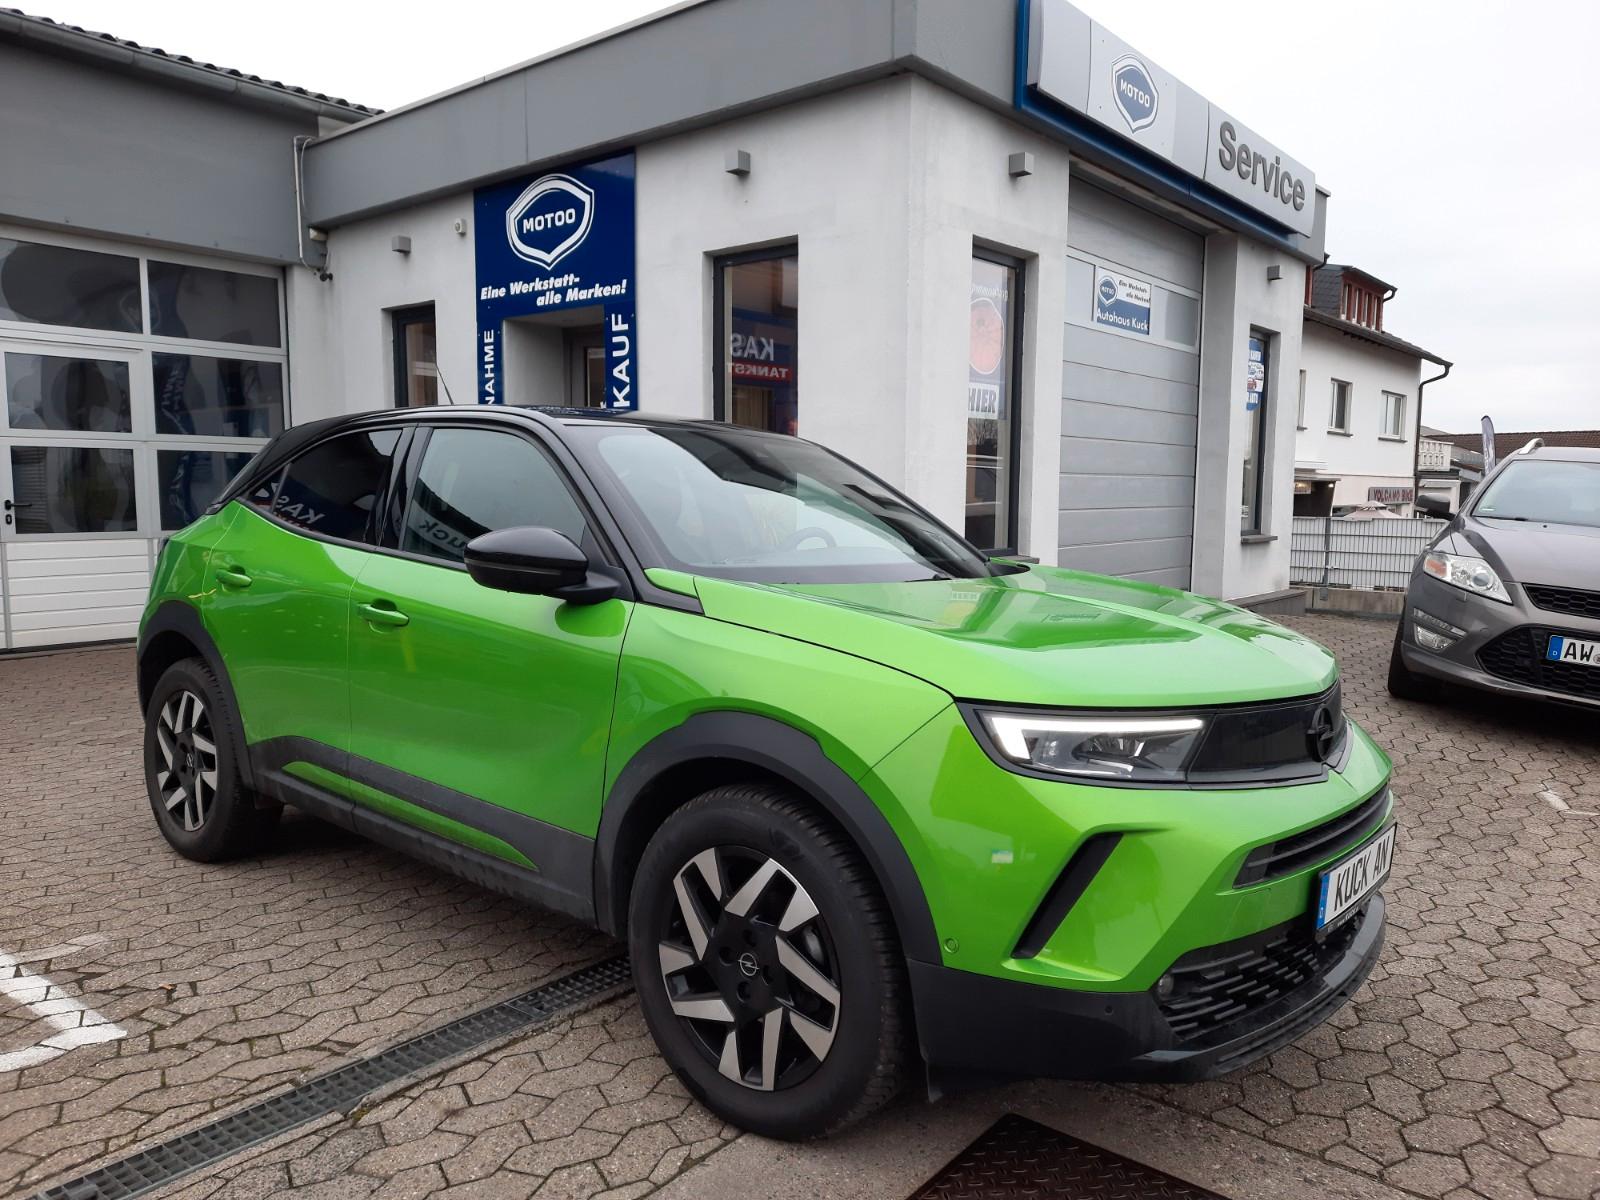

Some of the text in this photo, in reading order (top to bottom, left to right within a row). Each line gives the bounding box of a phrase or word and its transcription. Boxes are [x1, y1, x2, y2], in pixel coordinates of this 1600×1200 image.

[1120, 79, 1150, 108] MOTOO
[1219, 121, 1306, 212] Service
[523, 208, 576, 233] MOTOO
[480, 273, 580, 300] Eine Werkstatt-
[536, 279, 627, 306] alle Marken!
[1097, 308, 1149, 330] Autohaus Kuck
[612, 313, 630, 408] KAUF
[1564, 642, 1594, 662] AW
[1334, 835, 1390, 912] KUCK AN
